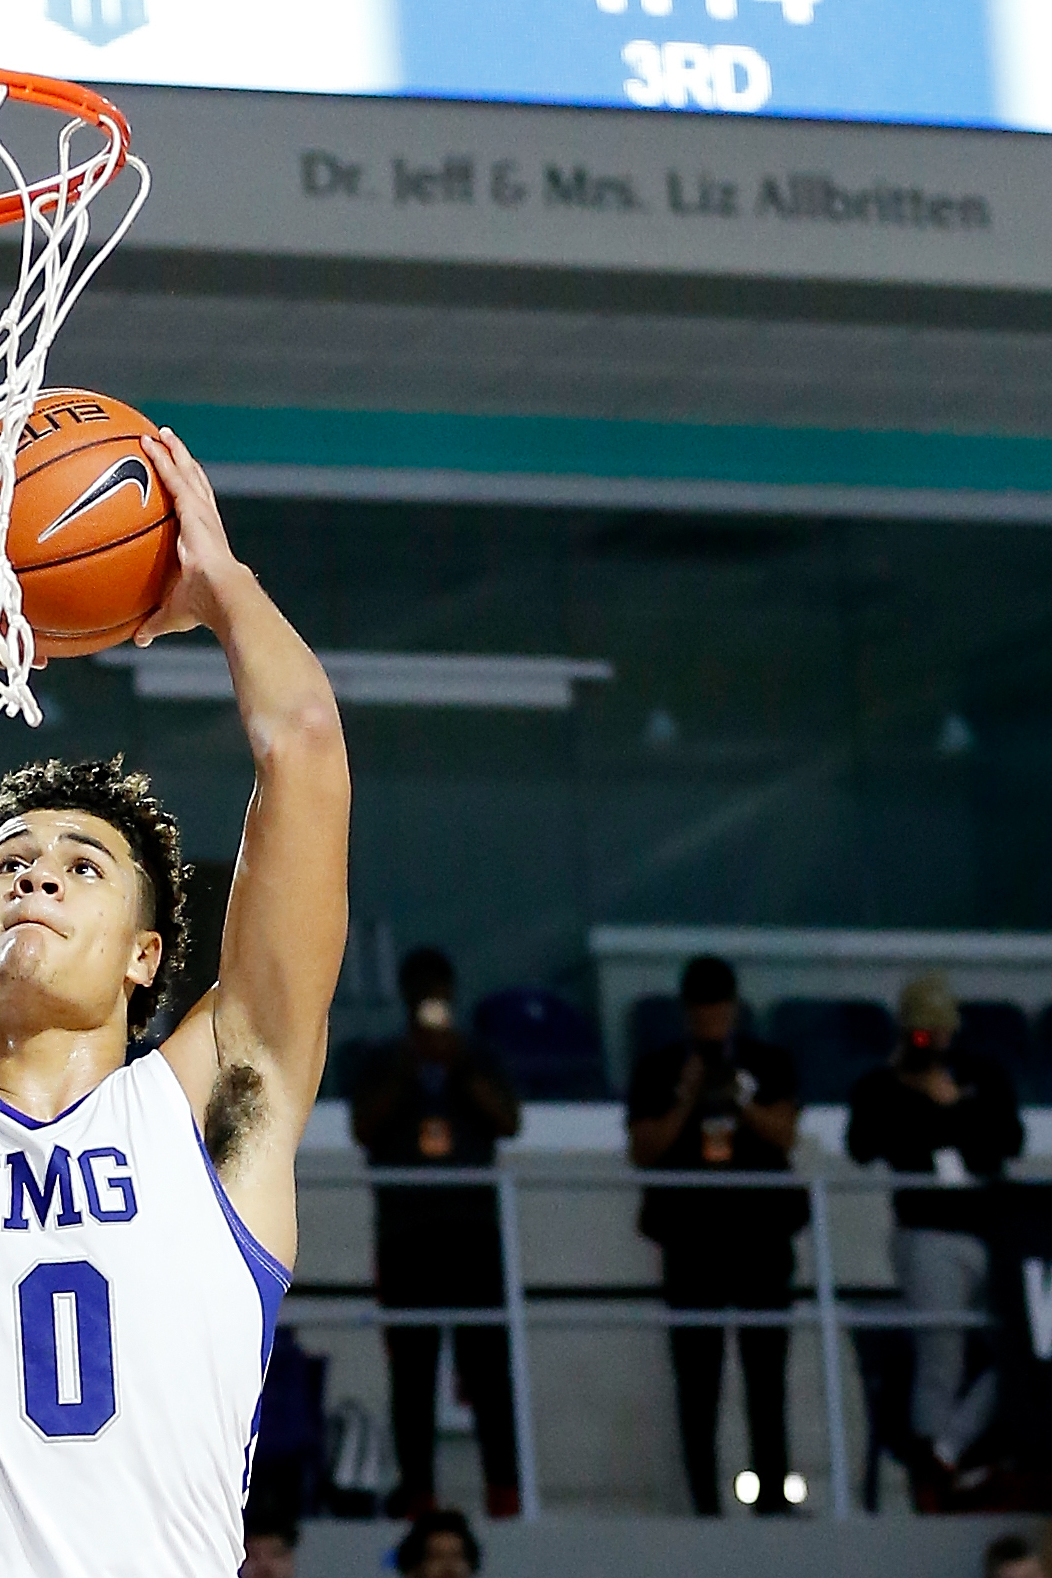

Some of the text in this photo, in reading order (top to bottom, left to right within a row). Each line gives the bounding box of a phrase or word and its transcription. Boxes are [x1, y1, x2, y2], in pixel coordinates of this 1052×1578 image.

[621, 39, 772, 112] 3RD
[299, 147, 371, 201] Dr.
[491, 158, 528, 204] &
[543, 160, 648, 213] Mrs.
[664, 167, 739, 219] Liz
[13, 1255, 121, 1443] 0
